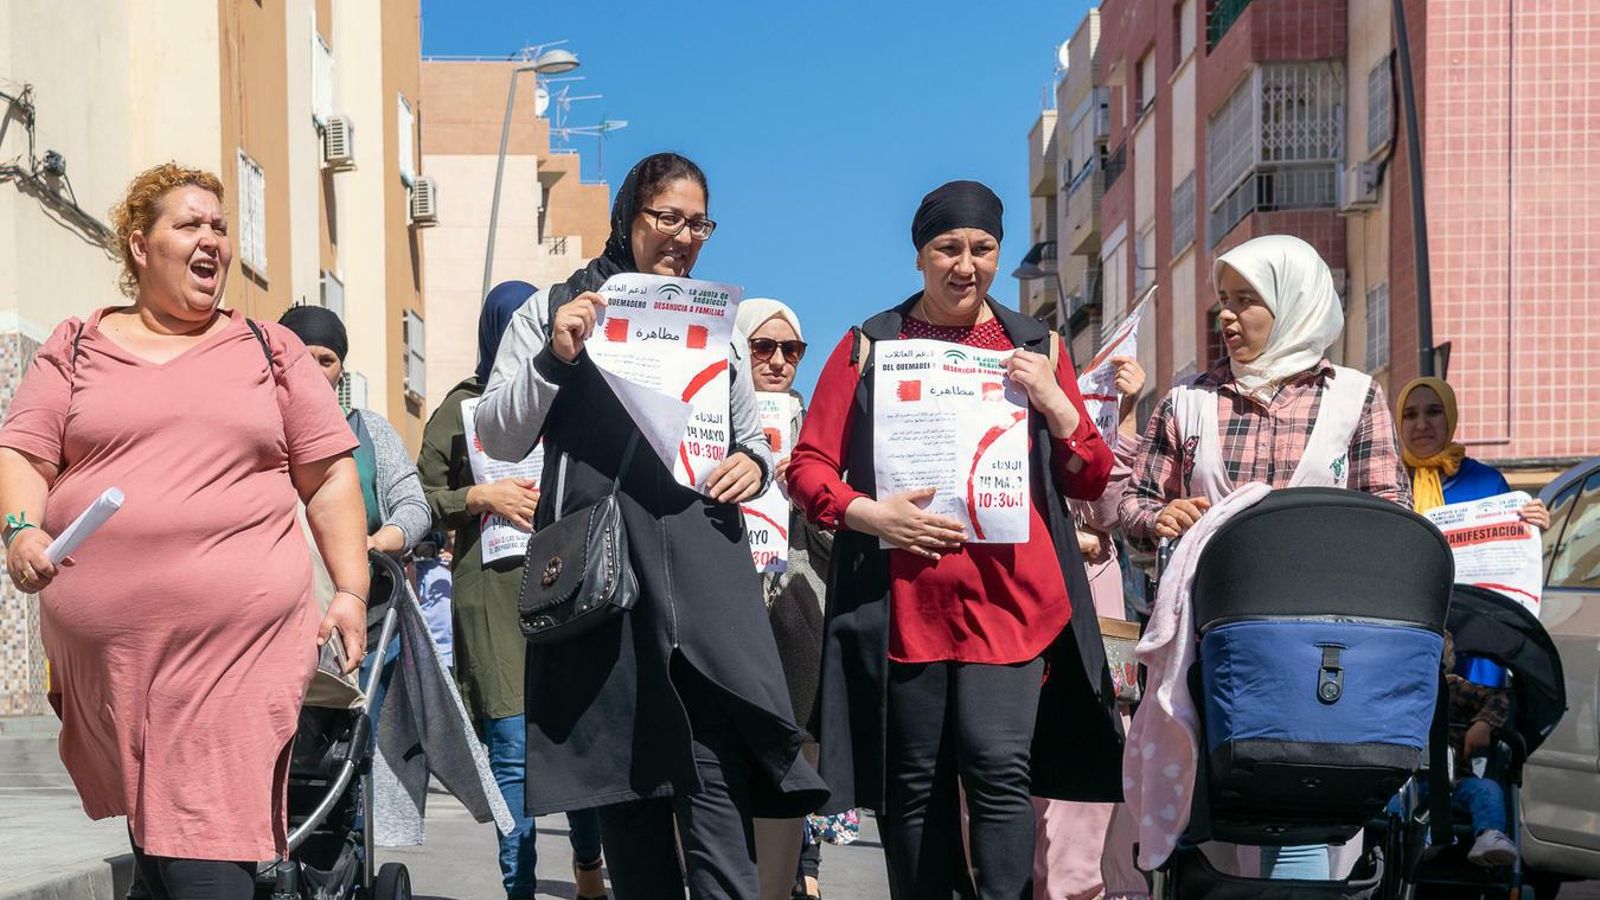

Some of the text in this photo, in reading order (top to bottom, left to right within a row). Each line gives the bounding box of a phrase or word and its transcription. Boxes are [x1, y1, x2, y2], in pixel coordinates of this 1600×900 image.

[608, 297, 647, 309] QUEMADERO
[654, 301, 688, 313] DESAHUCIA
[695, 306, 725, 317] FAMILIAS
[882, 363, 894, 371] DEL
[687, 426, 725, 442] 14 MAYO
[688, 441, 725, 462] 10:30H
[748, 529, 768, 545] AYO
